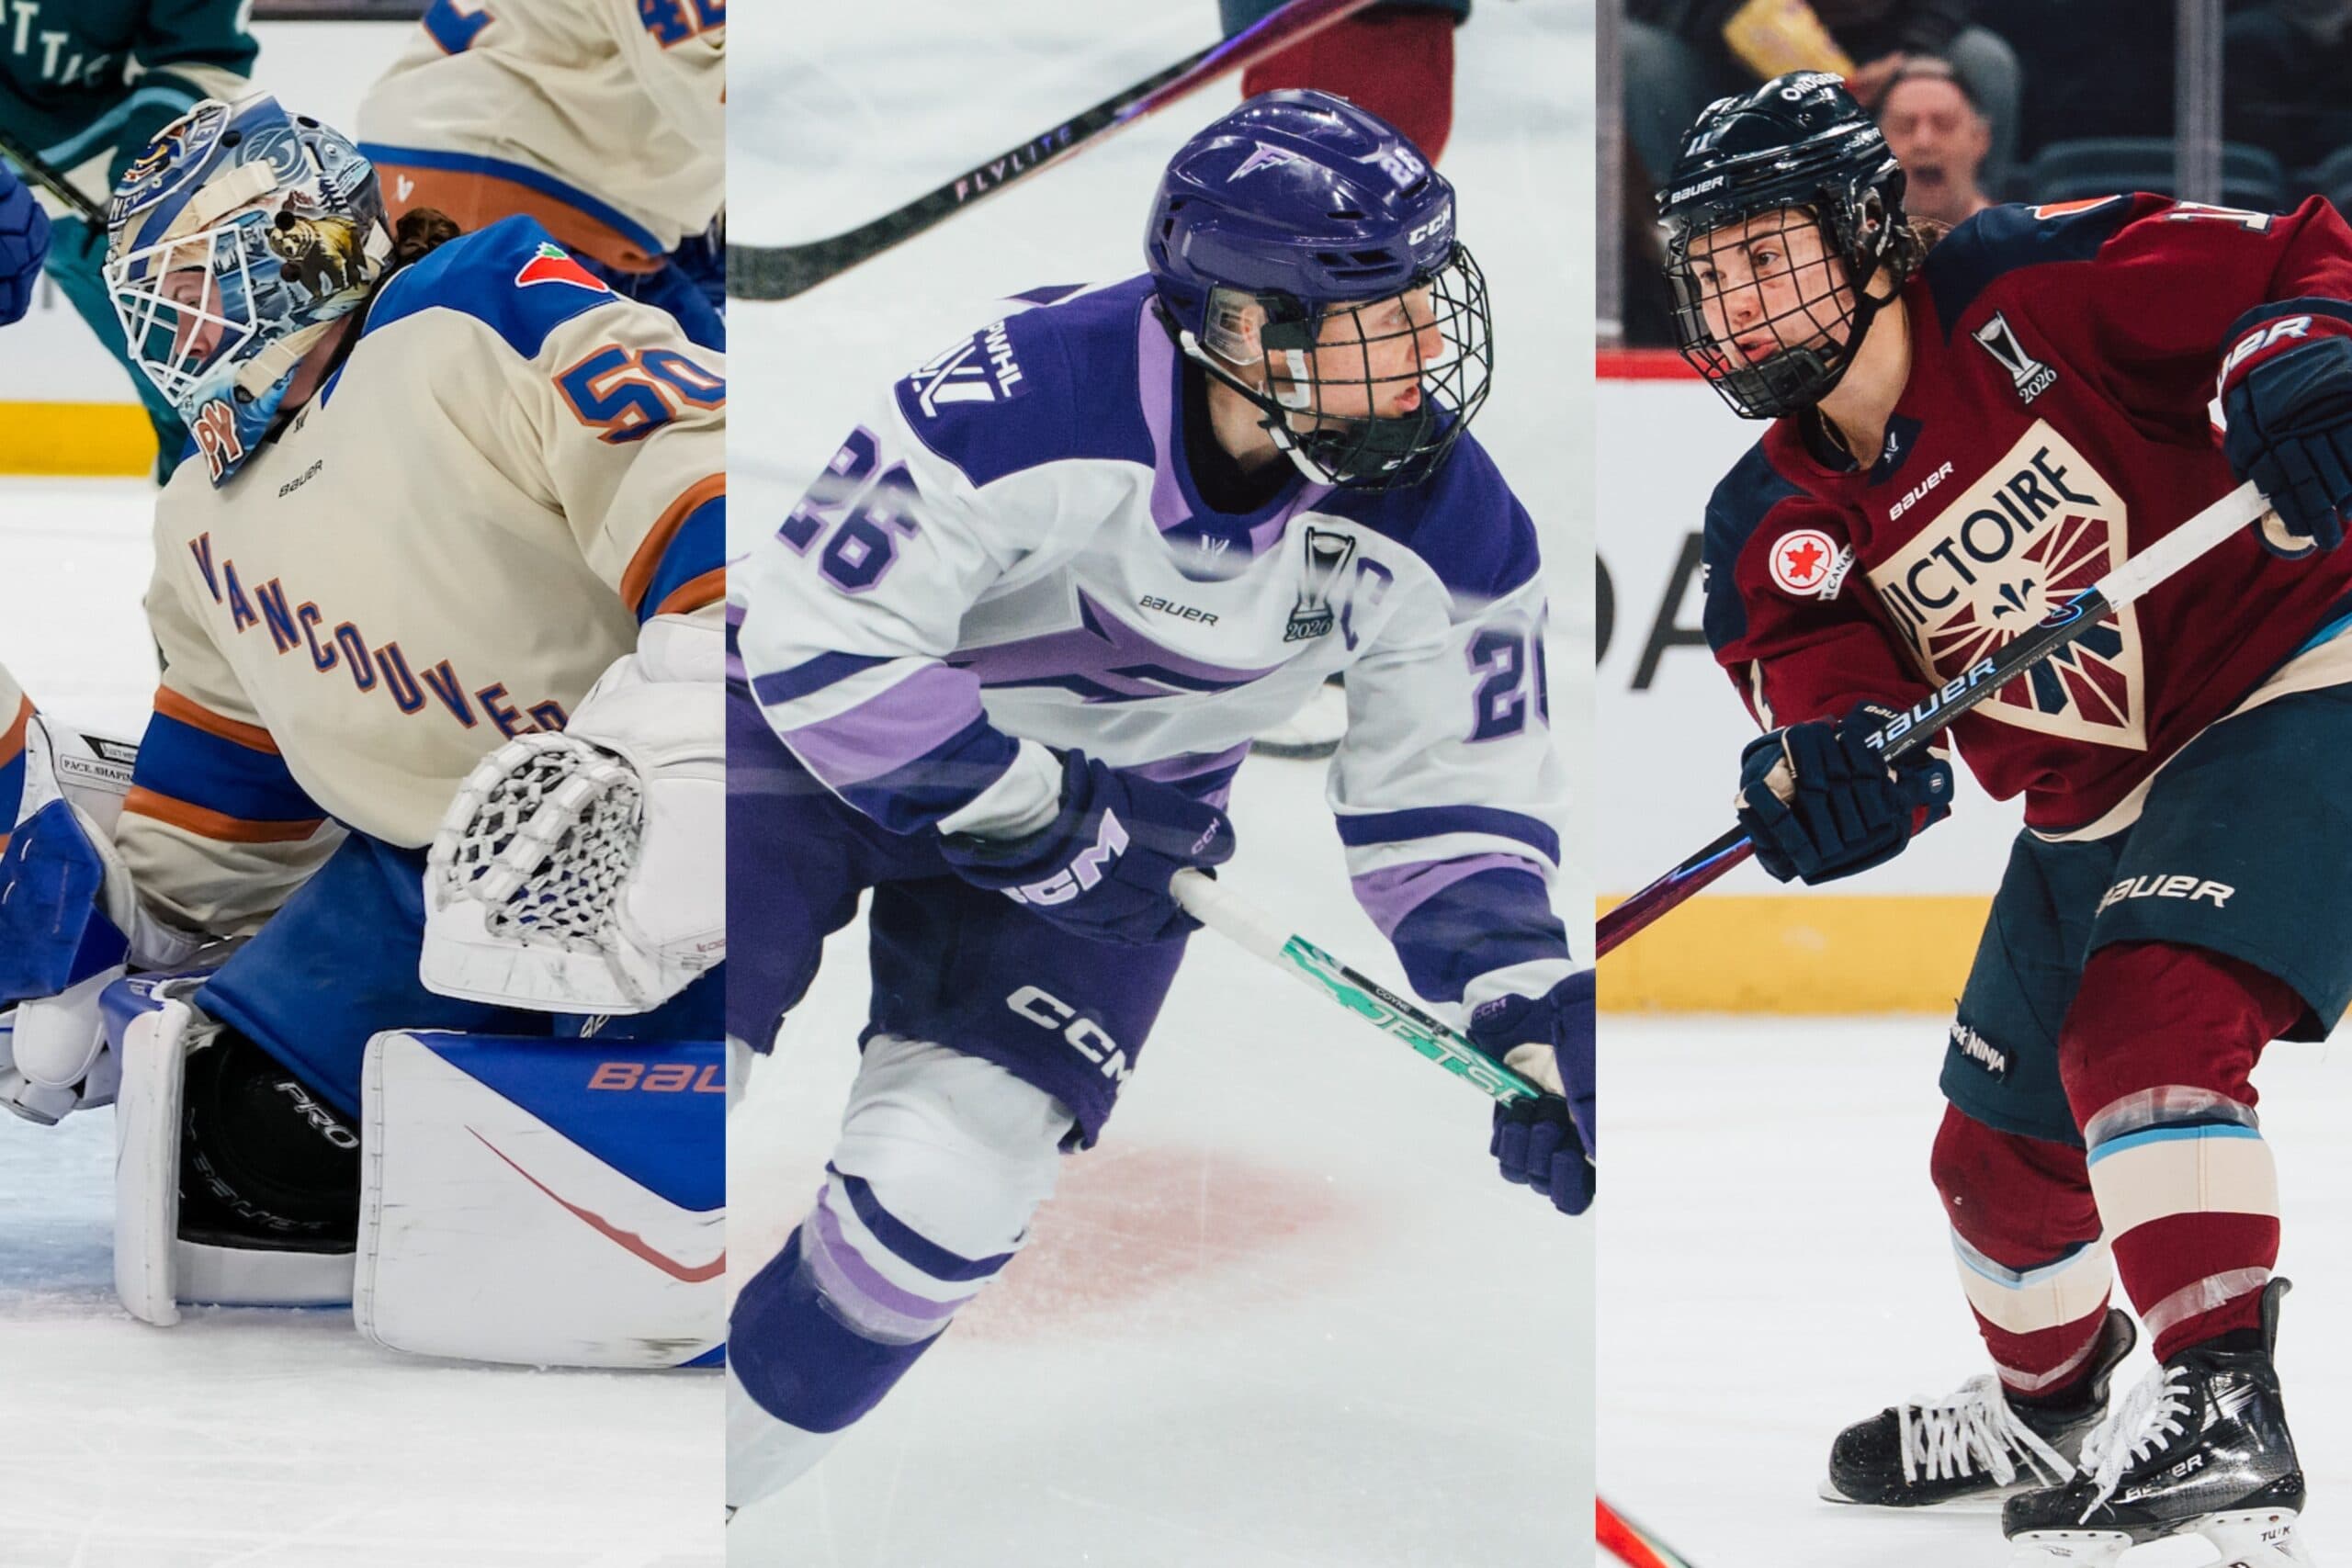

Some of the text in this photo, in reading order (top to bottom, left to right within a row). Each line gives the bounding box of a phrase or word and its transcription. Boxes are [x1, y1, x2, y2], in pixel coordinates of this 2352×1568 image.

[956, 125, 1072, 201] FLYLITE
[1670, 175, 1724, 204] BAUER
[551, 343, 726, 446] 50
[2019, 367, 2057, 404] 2026
[278, 459, 323, 498] BAUER
[1889, 461, 1954, 522] BAUER
[1139, 595, 1219, 626] BAUER
[1286, 618, 1333, 641] 2026
[1191, 817, 1221, 855] CCM
[1006, 985, 1133, 1081] CCM
[276, 1082, 359, 1149] PRO
